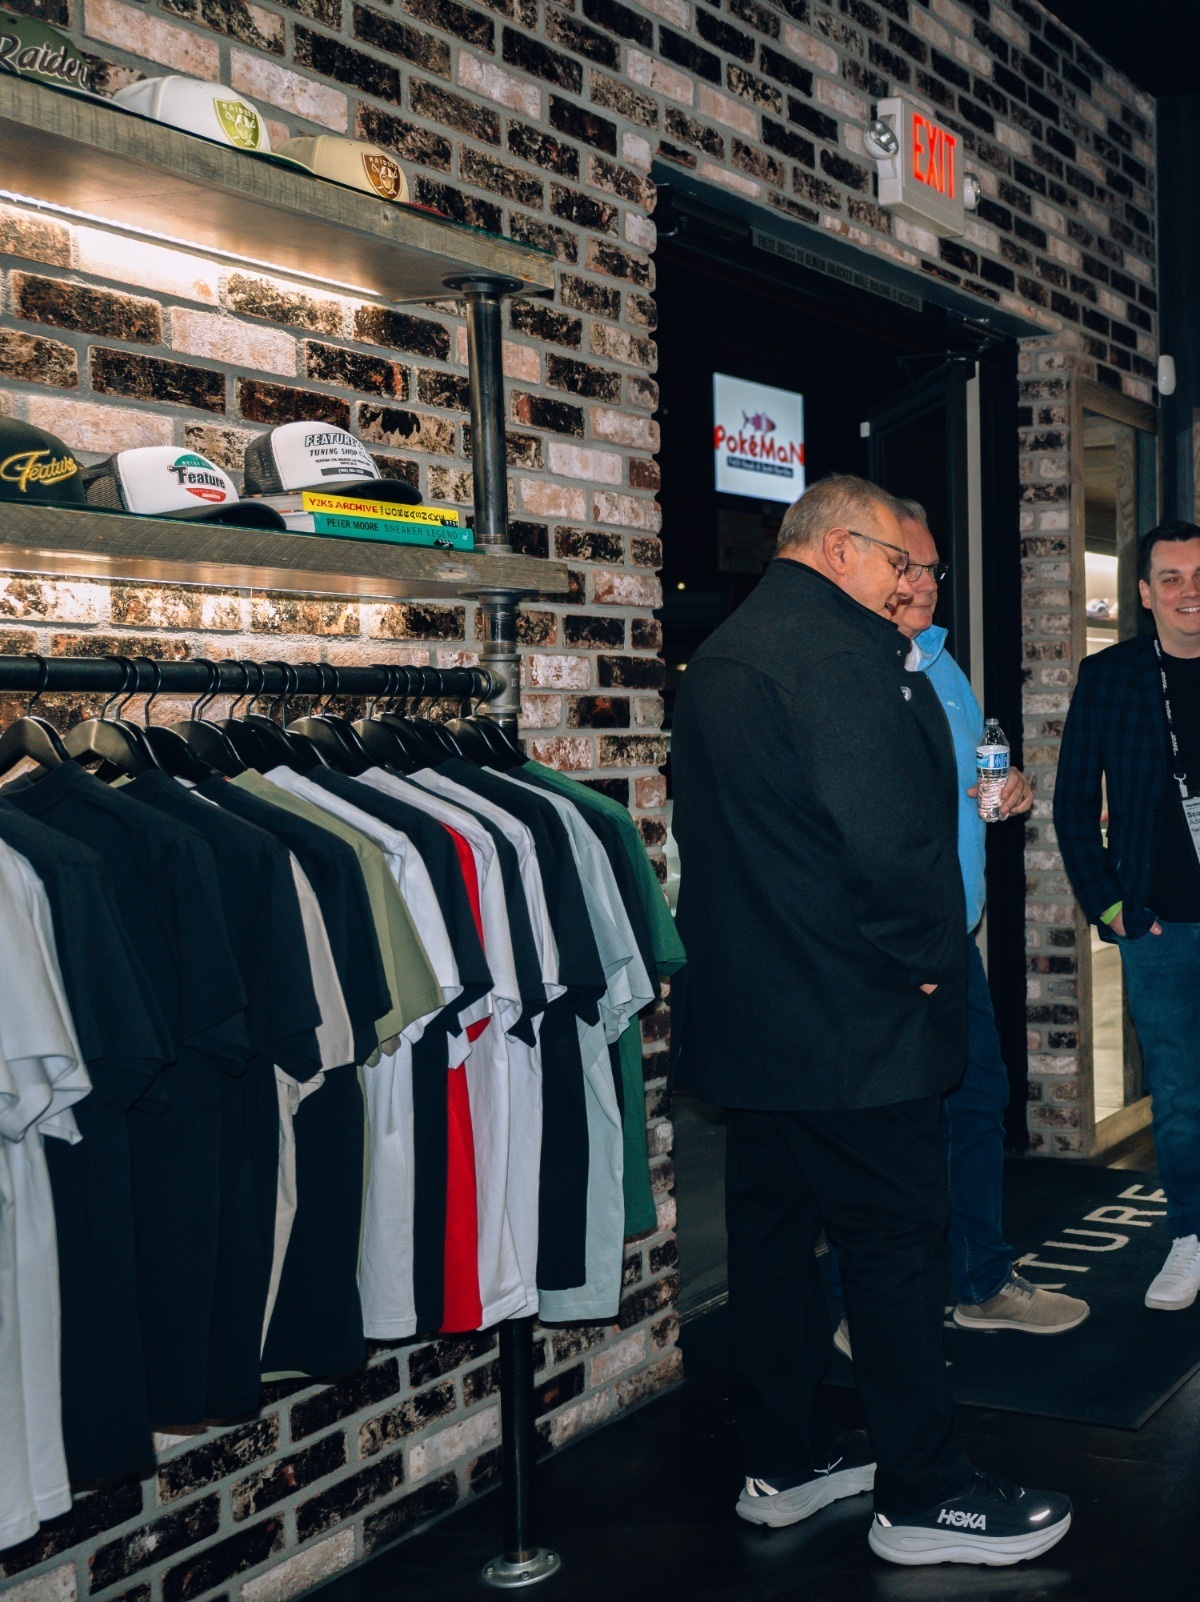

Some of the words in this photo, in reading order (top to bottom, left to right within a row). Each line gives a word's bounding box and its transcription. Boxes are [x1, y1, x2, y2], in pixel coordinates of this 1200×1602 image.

[913, 112, 957, 199] EXIT
[310, 448, 338, 456] TUNING
[341, 448, 358, 456] SHOP
[167, 465, 226, 489] Feature
[336, 502, 378, 513] ARCHIVE
[327, 518, 350, 529] PETER
[353, 521, 379, 531] MOORE
[384, 524, 422, 535] SNEAKER
[426, 529, 458, 539] LEGEND
[937, 1508, 987, 1531] HOKA
